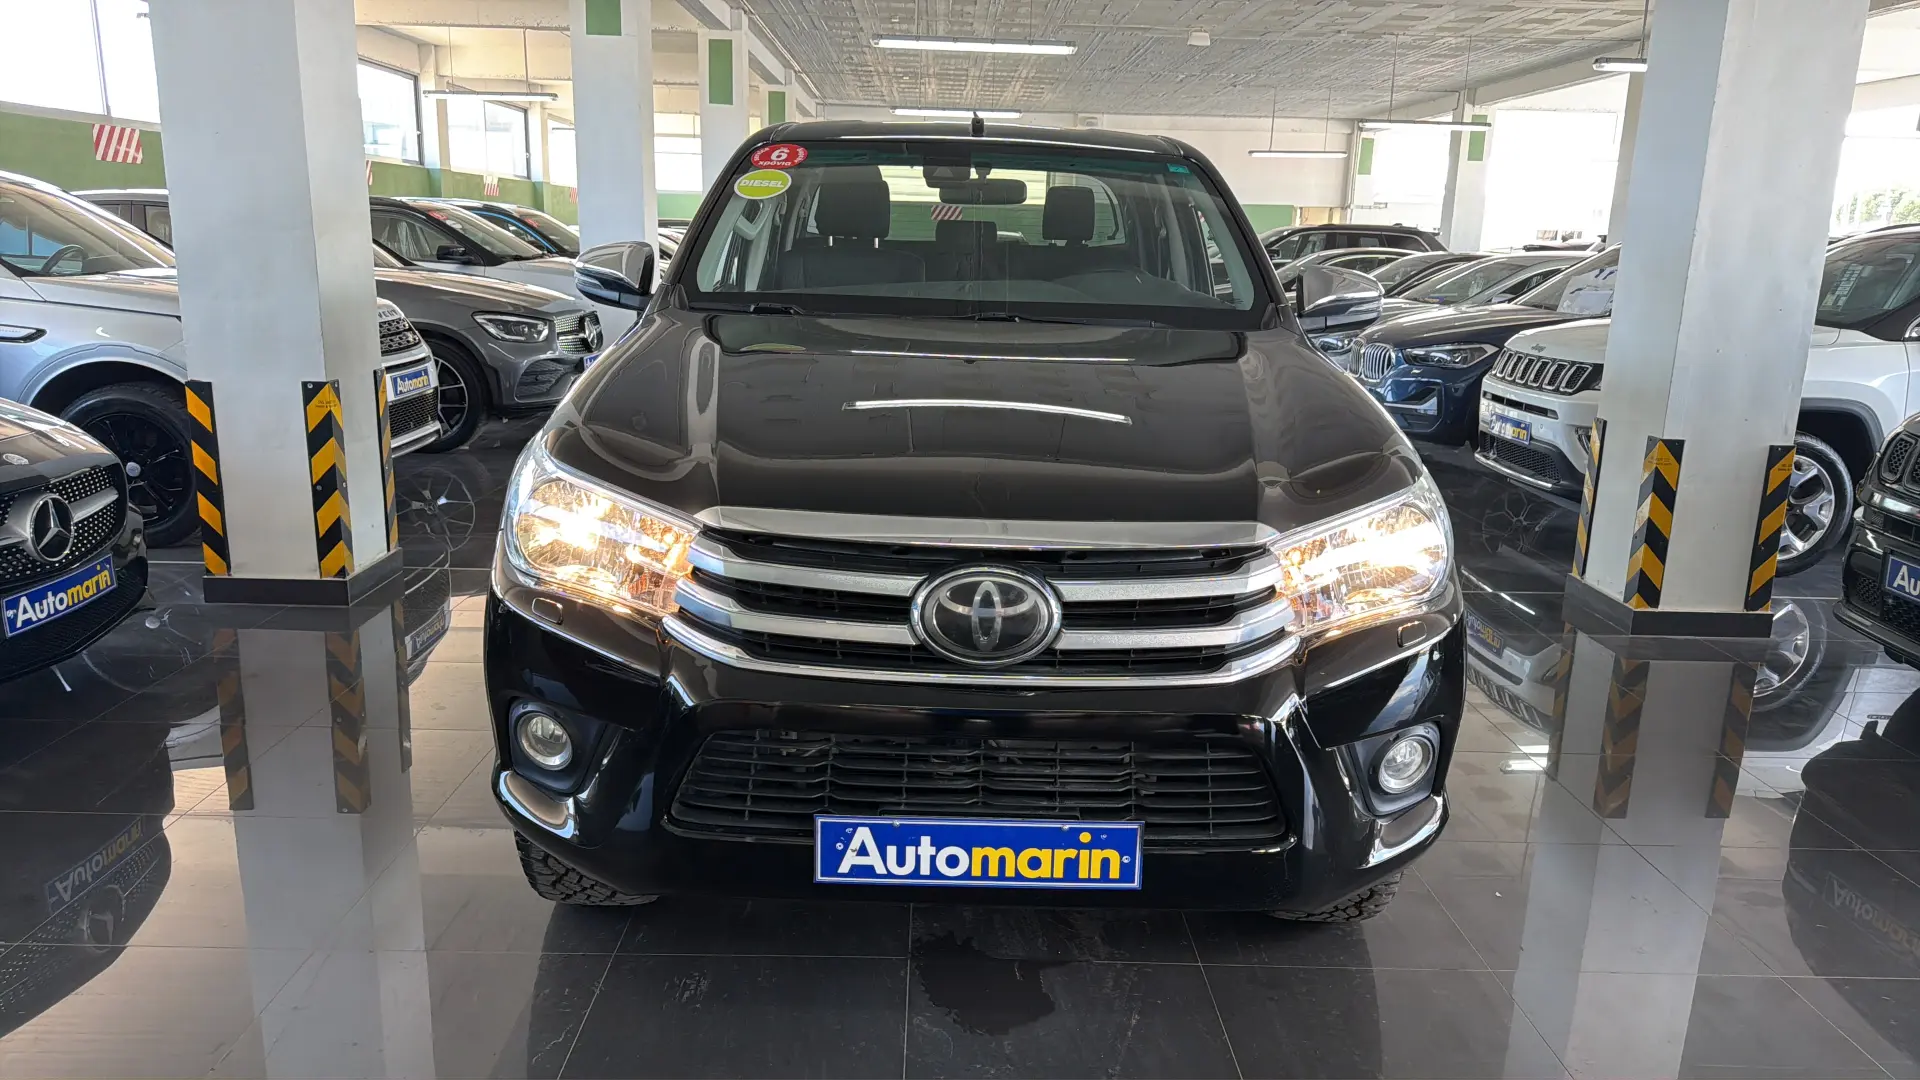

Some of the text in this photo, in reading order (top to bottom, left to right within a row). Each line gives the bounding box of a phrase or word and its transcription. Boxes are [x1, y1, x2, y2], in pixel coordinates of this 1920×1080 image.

[770, 149, 790, 161] 6
[739, 179, 784, 188] DIESEL
[396, 370, 429, 394] Automarin
[1892, 564, 1920, 596] Au
[16, 564, 111, 629] Automarin
[837, 826, 1120, 880] Automarin
